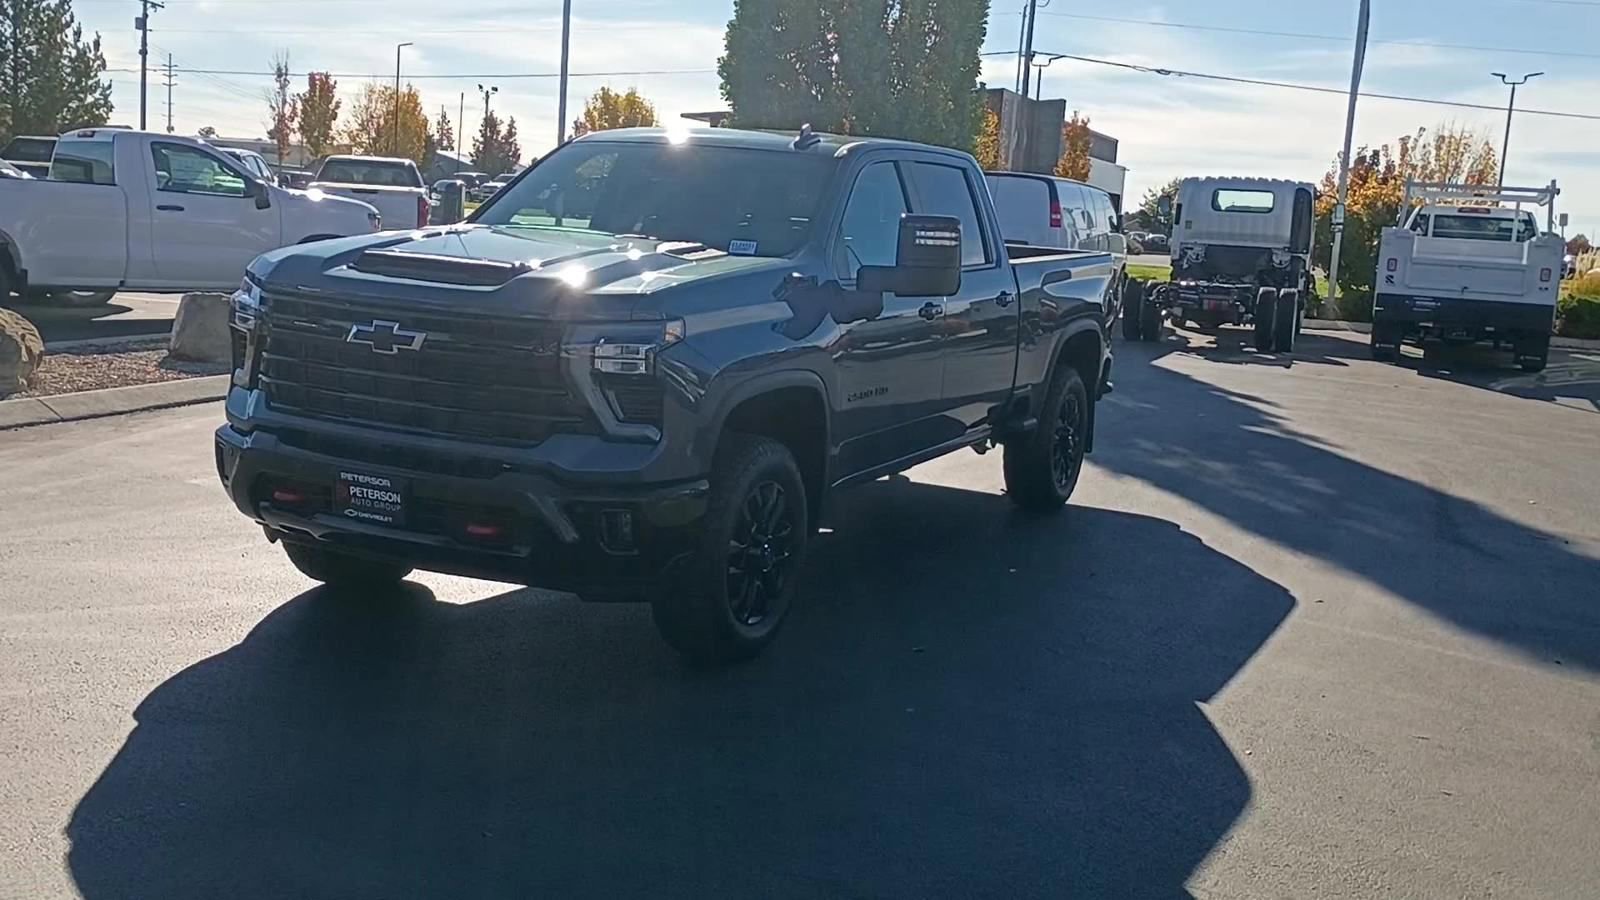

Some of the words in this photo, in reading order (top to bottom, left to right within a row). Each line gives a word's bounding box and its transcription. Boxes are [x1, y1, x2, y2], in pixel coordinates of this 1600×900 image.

[340, 472, 391, 487] PETERSON
[350, 486, 401, 503] PETERSON
[351, 498, 372, 507] AUTO
[374, 501, 401, 511] GROUP
